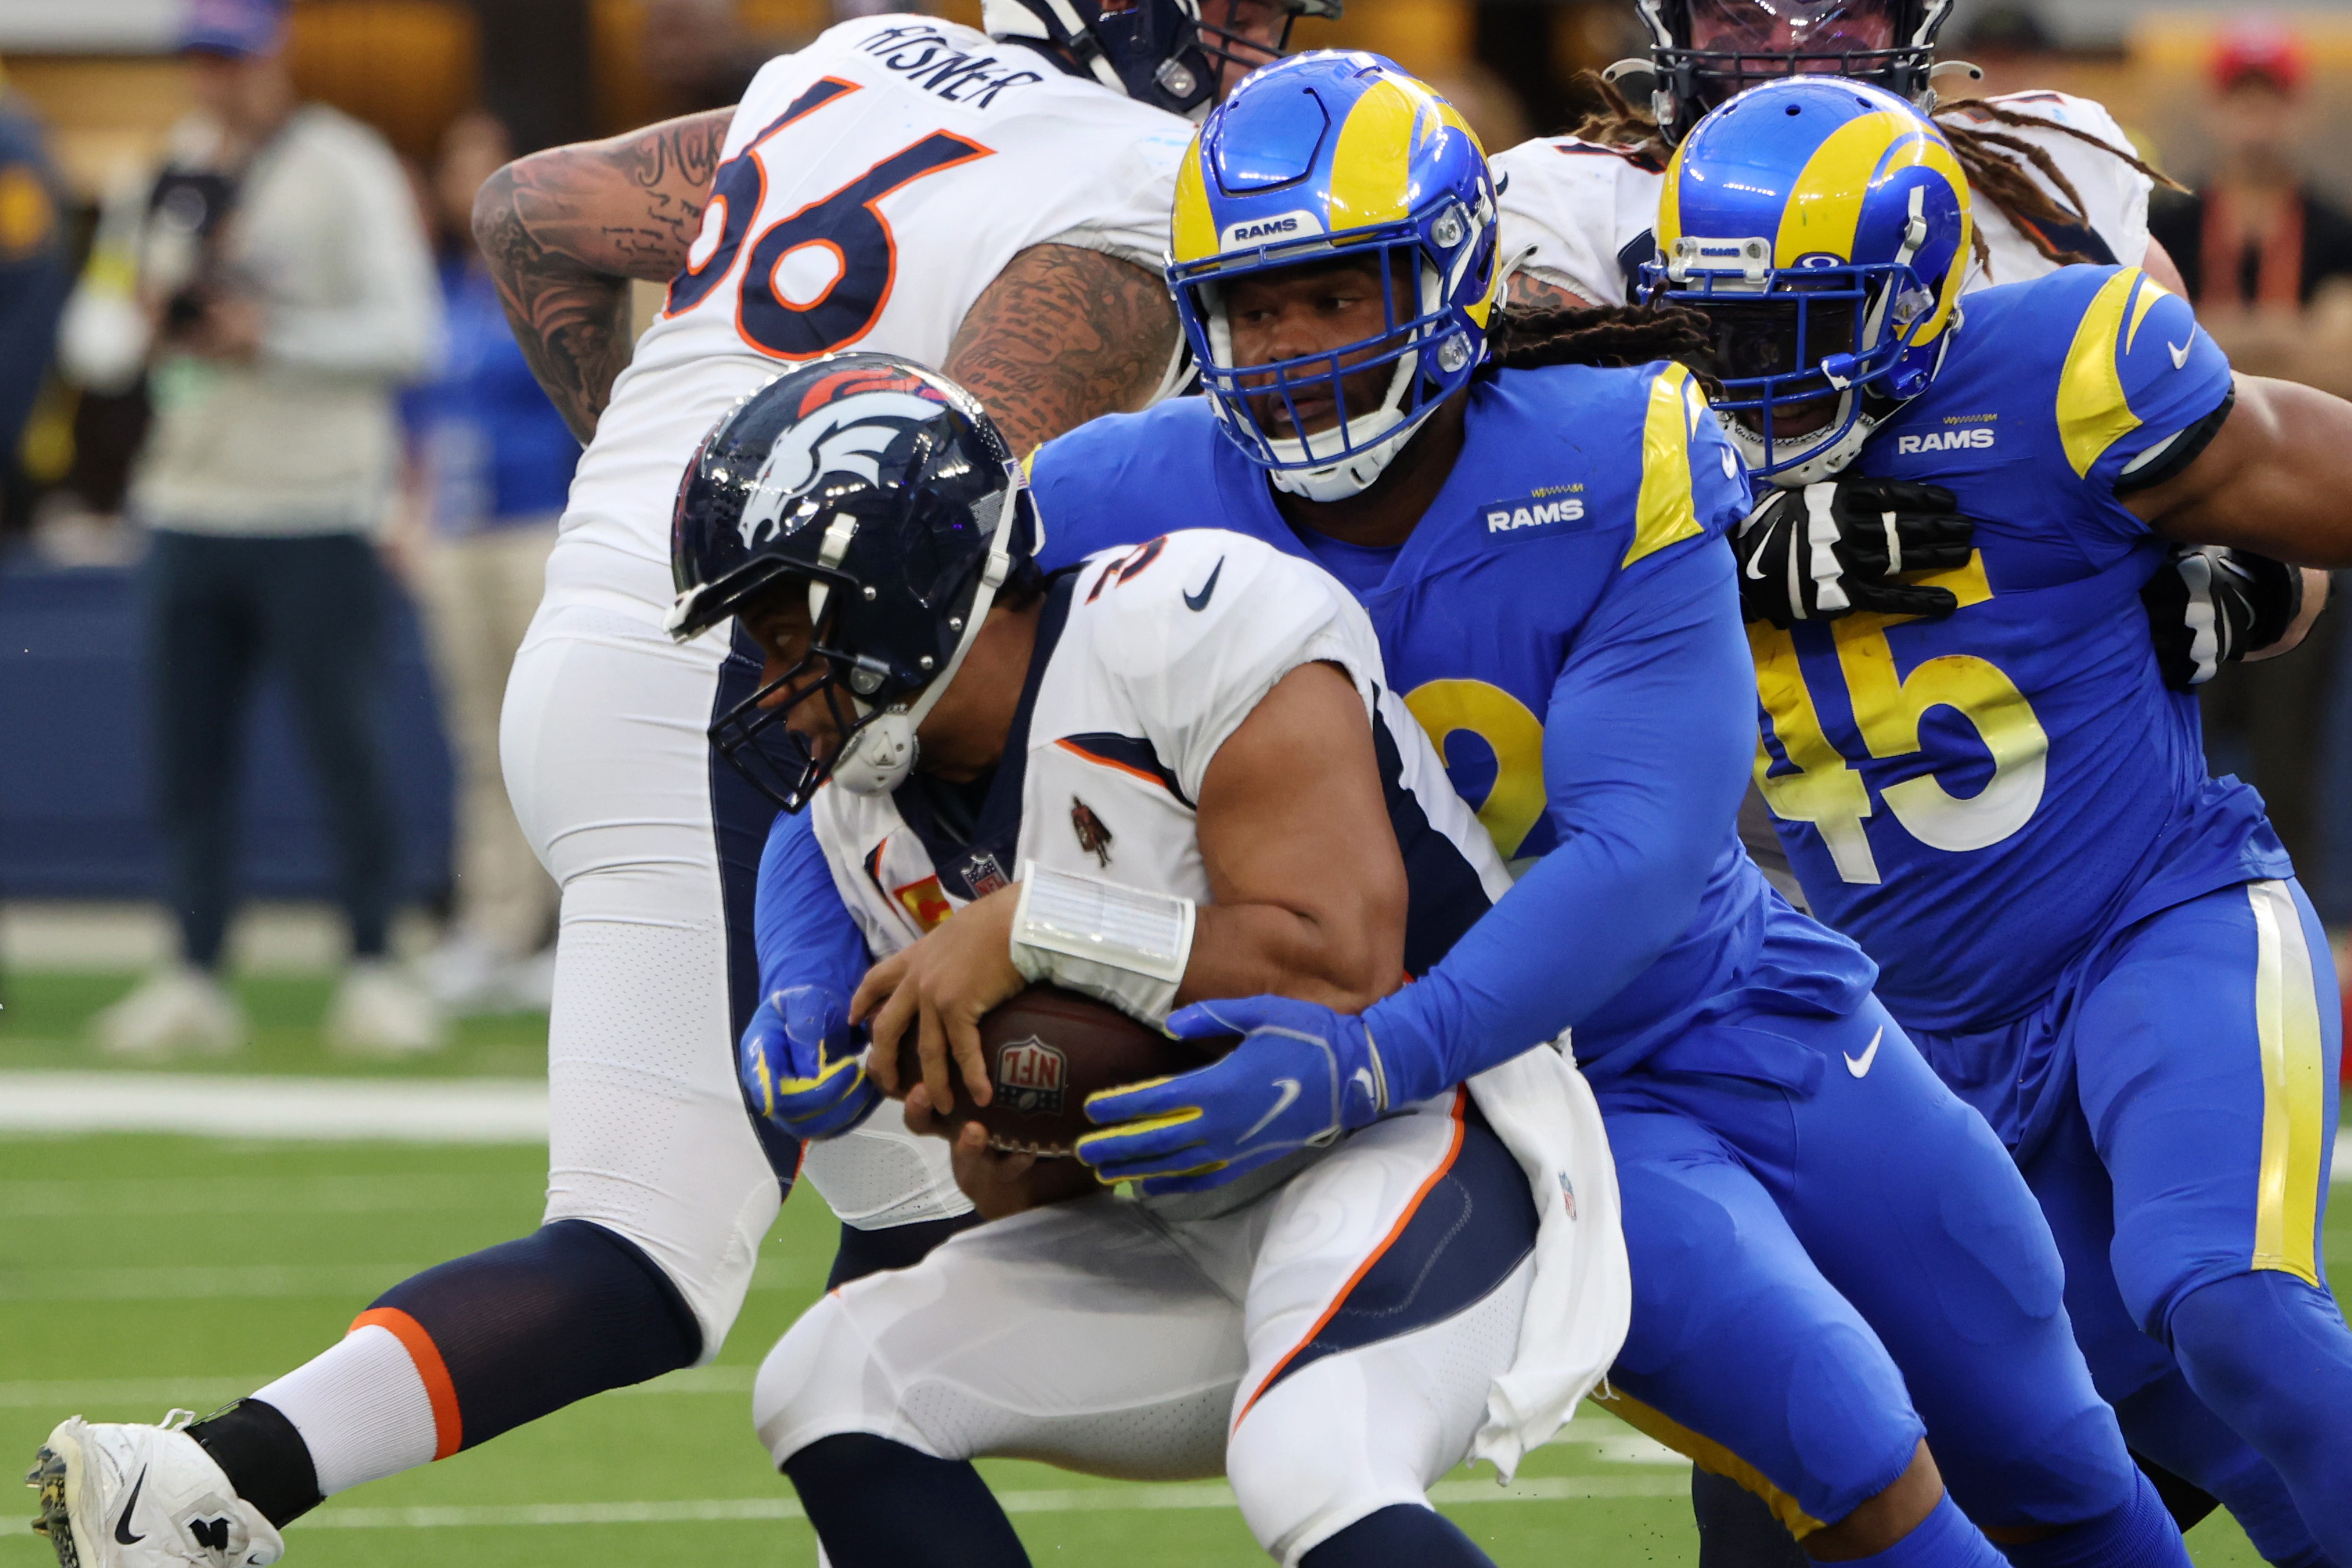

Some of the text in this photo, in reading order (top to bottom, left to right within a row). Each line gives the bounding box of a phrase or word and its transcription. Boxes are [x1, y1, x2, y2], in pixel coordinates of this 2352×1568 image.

[853, 26, 1044, 109] RISNER
[662, 75, 997, 361] 66
[1234, 217, 1299, 241] RAMS
[1898, 428, 1995, 455] RAMS
[1487, 498, 1584, 534] RAMS
[1746, 548, 2049, 885] 45
[1004, 1048, 1060, 1089] NFL
